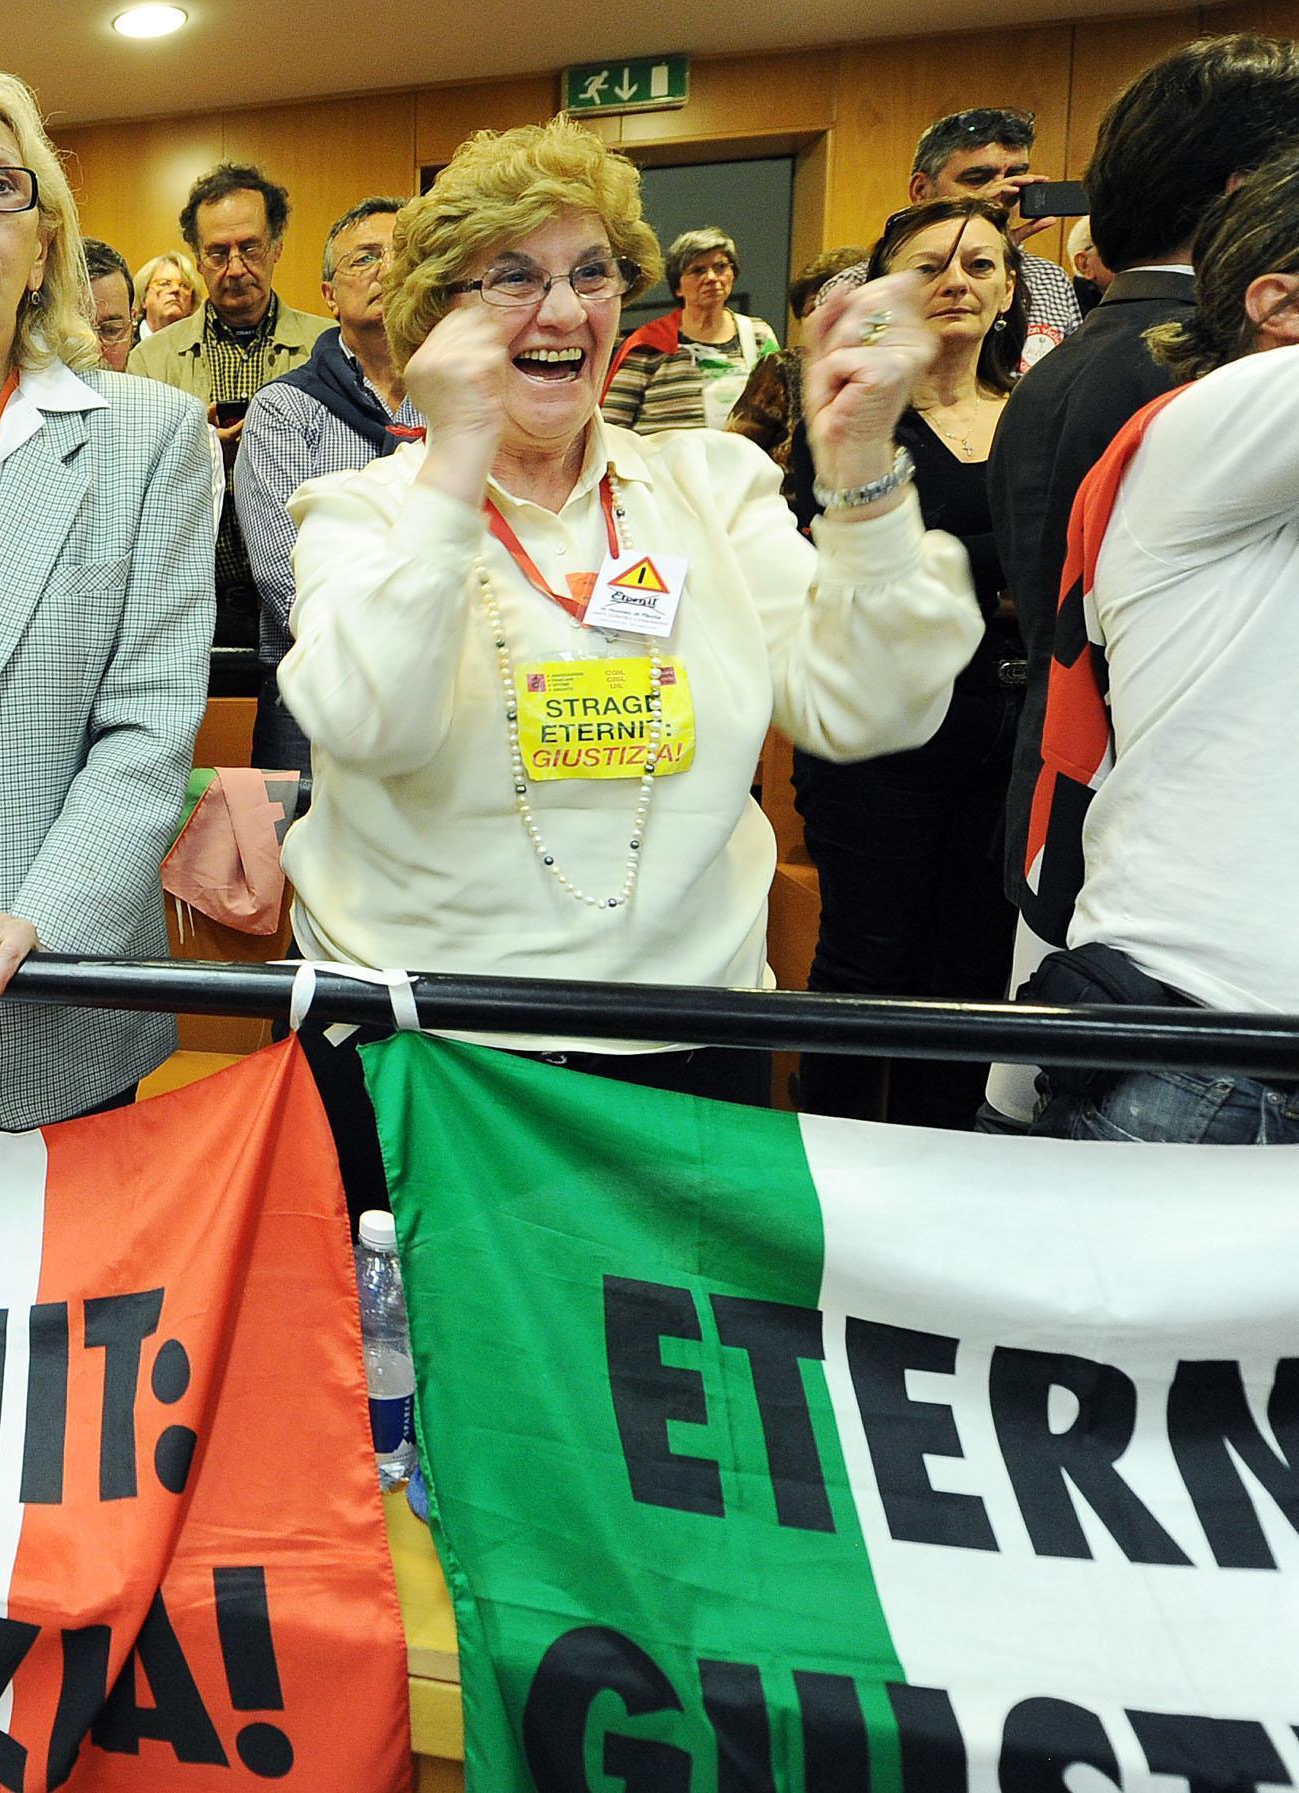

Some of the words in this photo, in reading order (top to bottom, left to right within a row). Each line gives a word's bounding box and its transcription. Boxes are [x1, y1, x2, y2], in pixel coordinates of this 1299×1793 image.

[540, 719, 672, 743] ETERNI:
[531, 743, 683, 768] GIUSTIZA!
[603, 1273, 1299, 1572] ETERN
